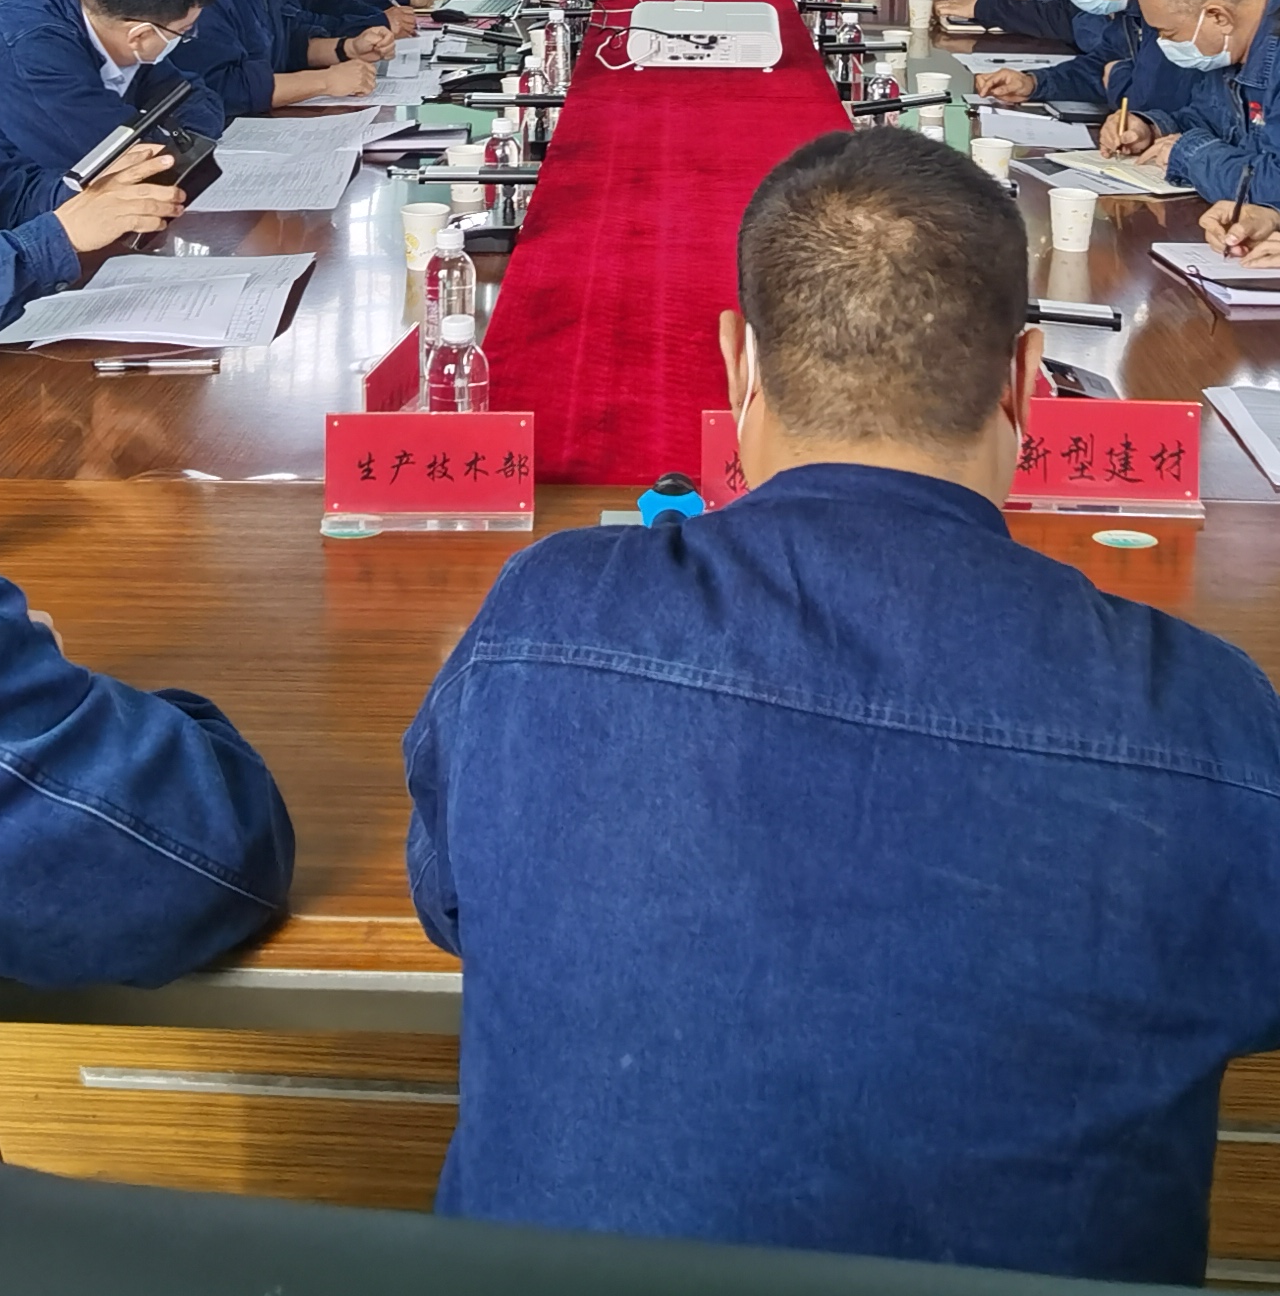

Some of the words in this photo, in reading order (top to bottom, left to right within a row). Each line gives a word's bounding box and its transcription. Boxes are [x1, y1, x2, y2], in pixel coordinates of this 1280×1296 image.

[356, 449, 531, 485] 生产技术部
[1017, 432, 1187, 484] 新型建材
